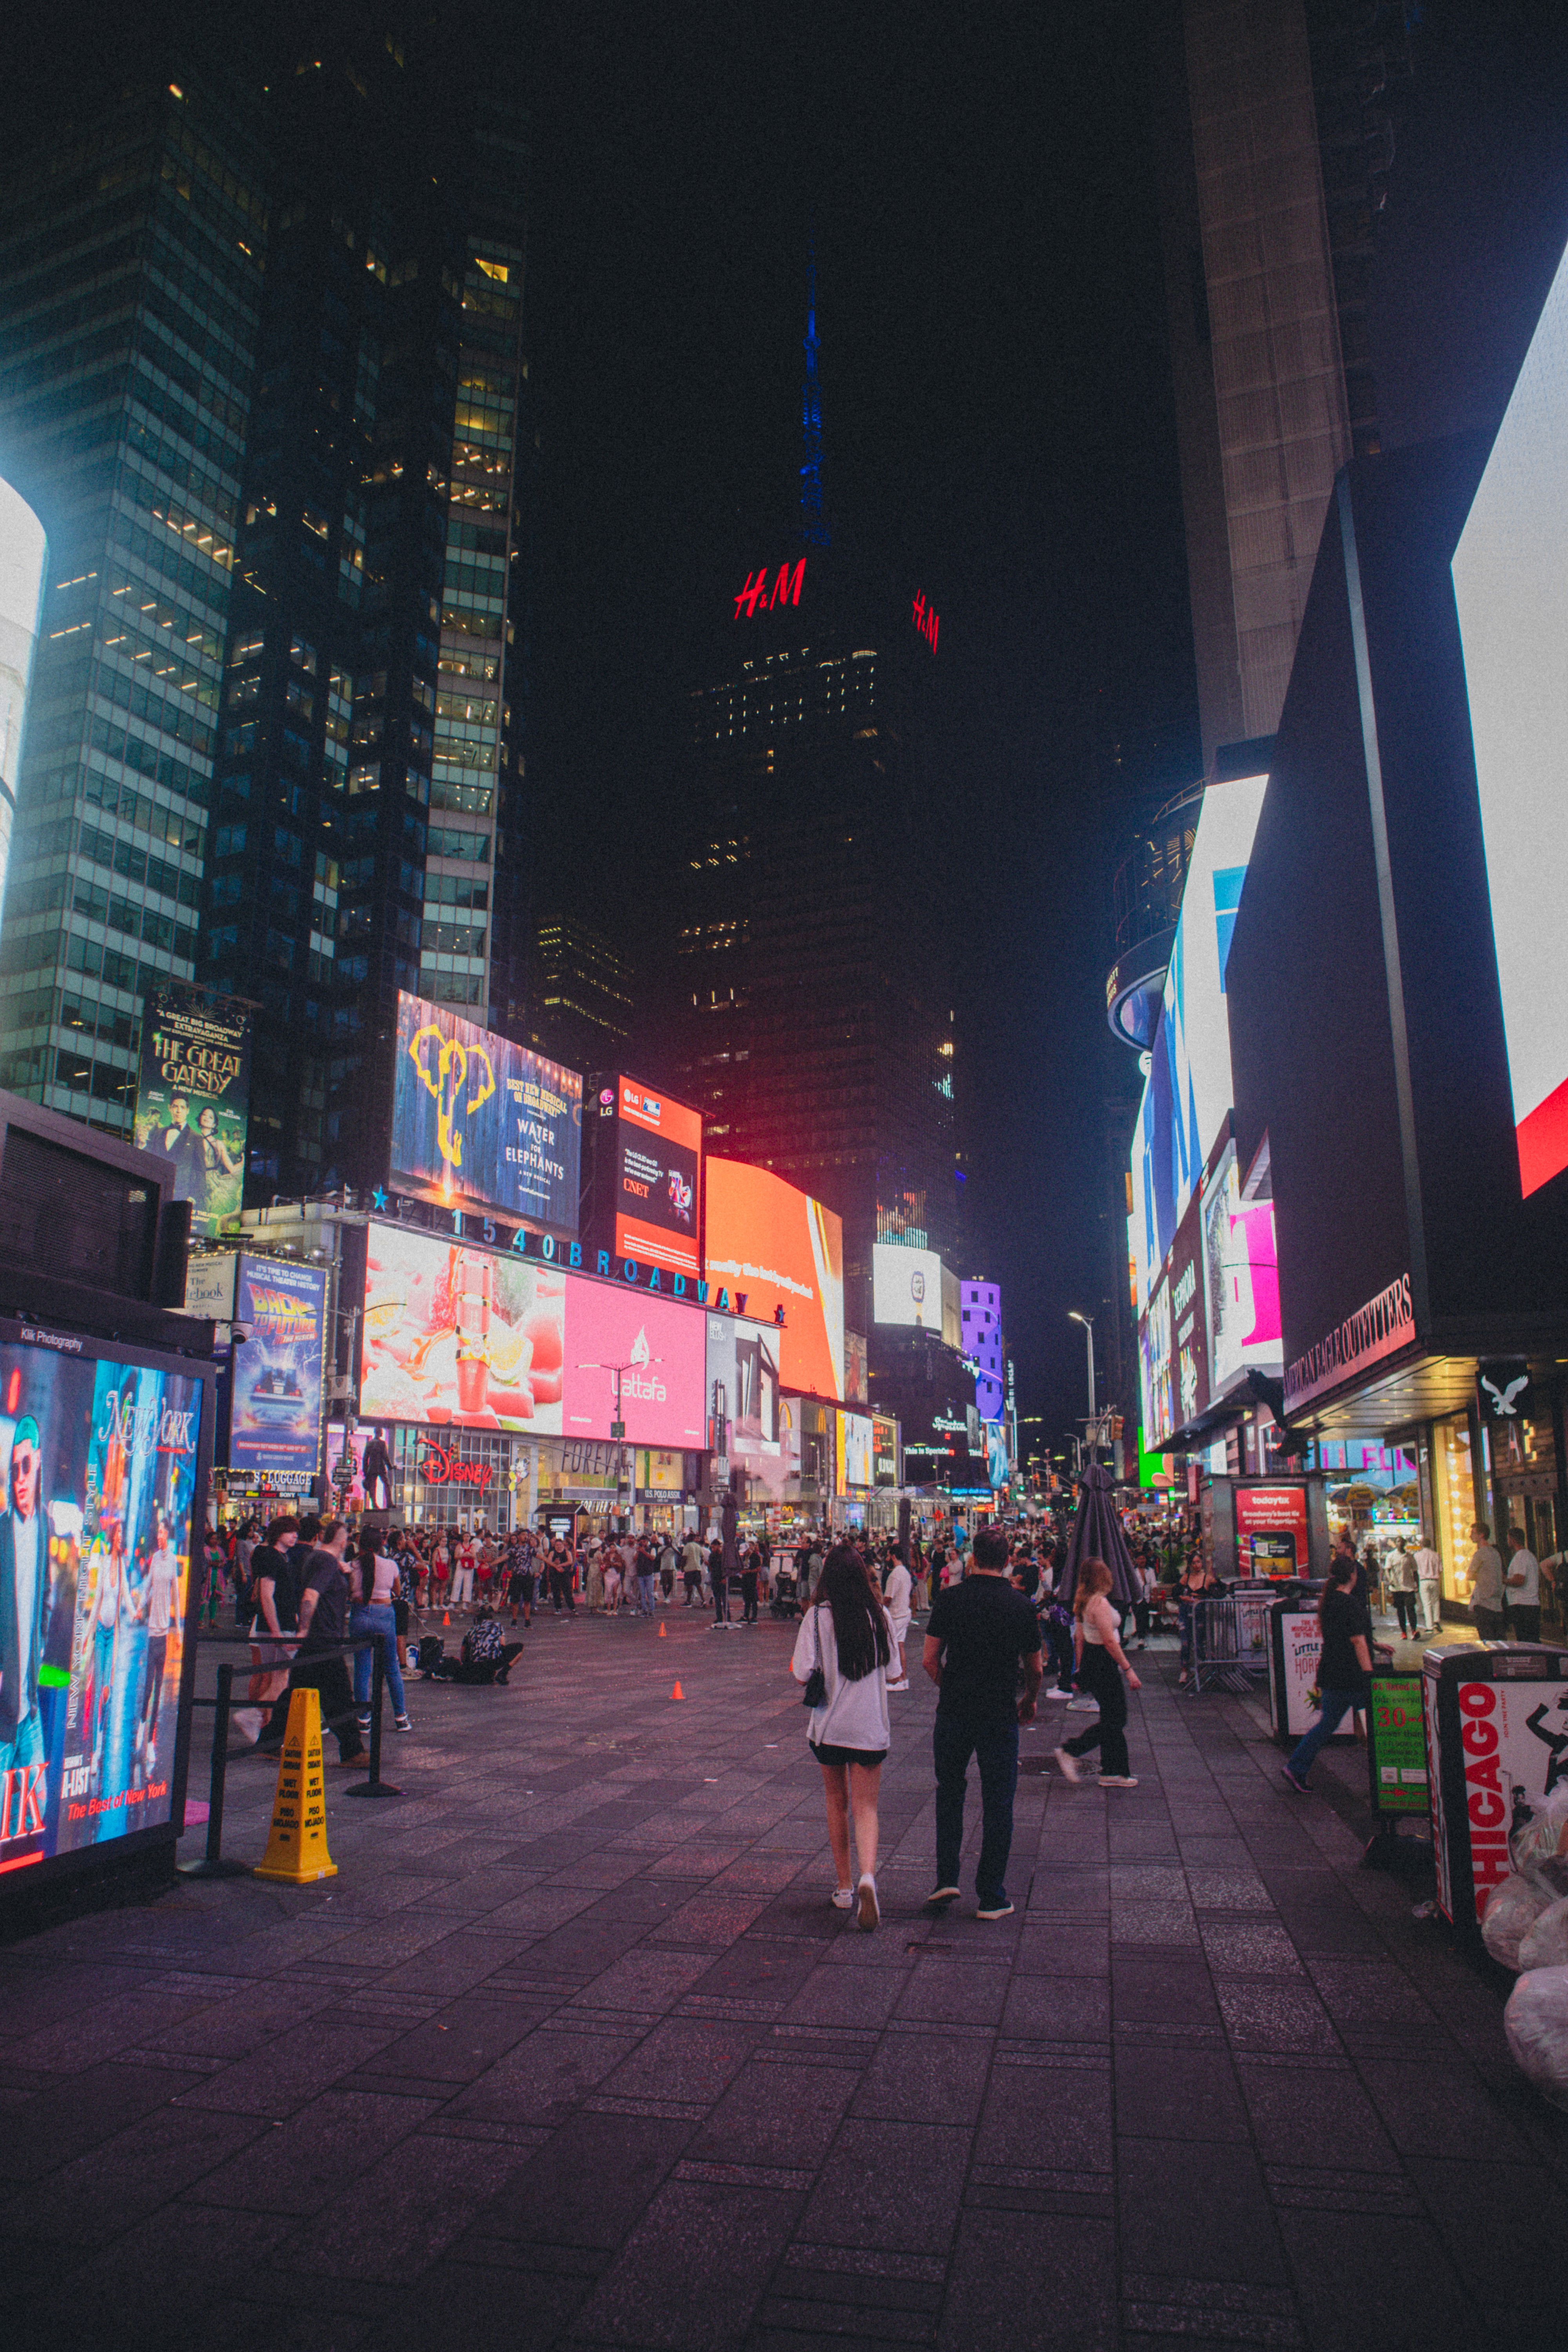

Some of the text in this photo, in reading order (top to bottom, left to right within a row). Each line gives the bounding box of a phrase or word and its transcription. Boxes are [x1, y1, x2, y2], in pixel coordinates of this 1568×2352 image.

[734, 557, 807, 619] H&M
[913, 589, 939, 655] H&M
[165, 1012, 190, 1024] GREAT
[191, 1018, 203, 1028] BIG
[204, 1021, 243, 1038] BROADWAY
[174, 1022, 229, 1042] EXTRAVAGANZA
[155, 1037, 243, 1077] THE GREAT
[161, 1061, 232, 1094] GATSBY
[192, 1089, 220, 1100] MUSICAL
[506, 1078, 524, 1092] BEST
[525, 1082, 540, 1097] NEW
[541, 1089, 567, 1114] MUSICAL
[514, 1091, 523, 1103] ON
[631, 1093, 639, 1105] LG
[600, 1106, 613, 1117] LG
[517, 1118, 555, 1146] WATER
[531, 1144, 541, 1154] FOR
[506, 1147, 564, 1180] ELEPHANTS
[534, 1174, 550, 1185] MUSICAL
[623, 1178, 649, 1198] CNET
[256, 1265, 267, 1273] IT'S
[268, 1267, 281, 1276] TIME
[289, 1271, 313, 1283] CHANGE
[569, 1242, 748, 1314] BROADWAY
[191, 1277, 205, 1285] The
[247, 1270, 320, 1291] MUSICAL THEATER HISTORY
[247, 1282, 317, 1317] BACK
[254, 1313, 317, 1336] TO FUTURE
[710, 1320, 722, 1331] NEW
[251, 1327, 267, 1337] THE
[283, 1332, 315, 1343] THE MUSICAL
[710, 1329, 726, 1341] BLUSH
[1283, 1272, 1412, 1402] AMERICAN EAGLE OUTFITTERS
[21, 1328, 83, 1352] Klik Photography
[267, 1472, 312, 1485] LUGGAGE
[1252, 1496, 1290, 1506] todaytix
[67, 1463, 98, 1729] NEW YORK NIGHT STYLE
[1295, 1642, 1319, 1656] LITTLE
[1373, 1682, 1410, 1691] #1 Rated
[1374, 1695, 1388, 1704] Our
[1403, 1729, 1423, 1737] than
[308, 1748, 321, 1757] CAUTION
[61, 1766, 91, 1799] A-LIST
[283, 1779, 297, 1788] WET
[309, 1777, 319, 1786] WET
[278, 1789, 299, 1799] FLOOR
[307, 1788, 322, 1798] FLOOR
[68, 1780, 167, 1821] The Best of New York
[279, 1807, 294, 1817] PISO
[309, 1806, 320, 1816] PISO
[273, 1818, 299, 1829] MOJADO
[305, 1816, 324, 1828] MOJADO
